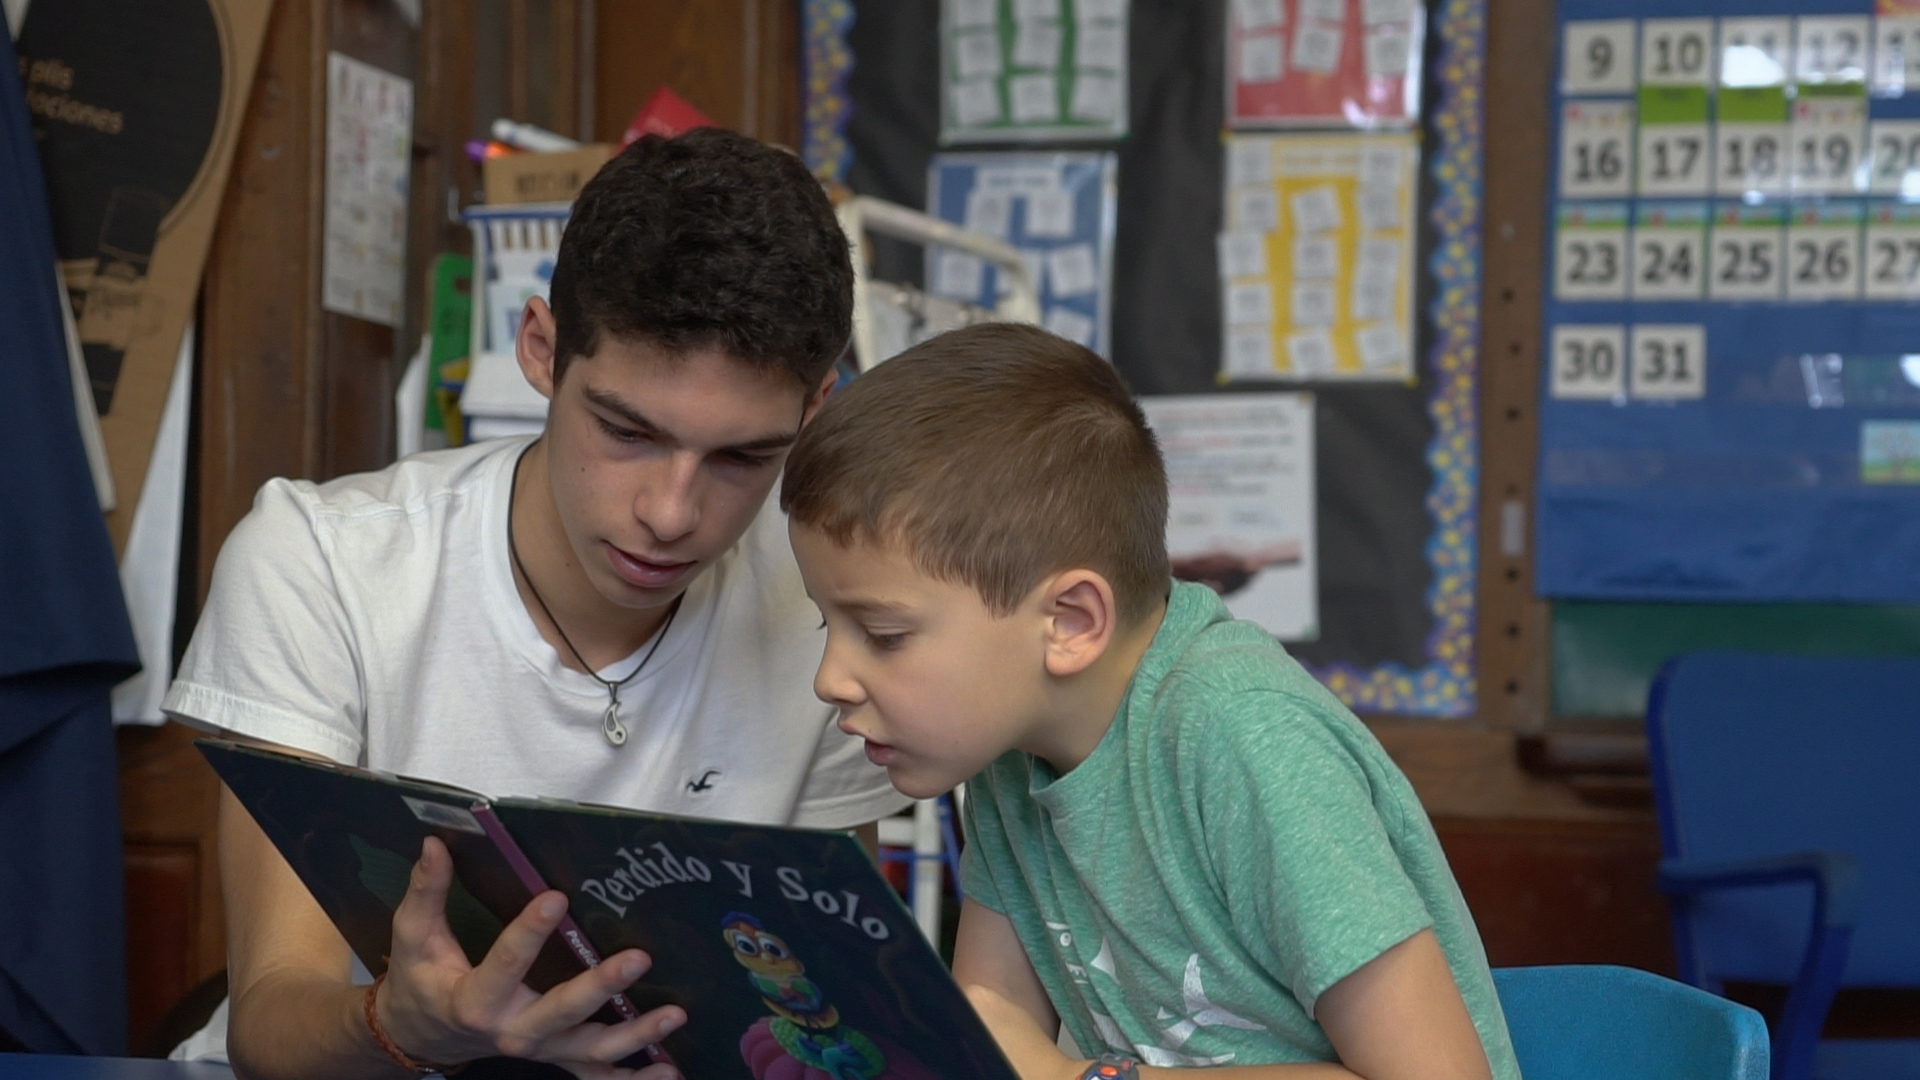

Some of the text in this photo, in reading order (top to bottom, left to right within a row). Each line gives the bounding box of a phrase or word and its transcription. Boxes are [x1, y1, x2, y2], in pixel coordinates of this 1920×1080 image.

[1587, 34, 1614, 79] 9
[1655, 33, 1705, 75] 10
[1808, 29, 1861, 73] 12
[1572, 138, 1622, 182] 16
[1652, 137, 1702, 178] 17
[1726, 136, 1778, 177] 18
[1801, 134, 1851, 176] 19
[1567, 241, 1618, 284] 23
[1641, 242, 1694, 284] 24
[1719, 241, 1772, 284] 25
[1795, 241, 1849, 283] 26
[1561, 340, 1694, 383] 30 31
[581, 841, 712, 919] Perdido
[776, 866, 889, 940] Solo
